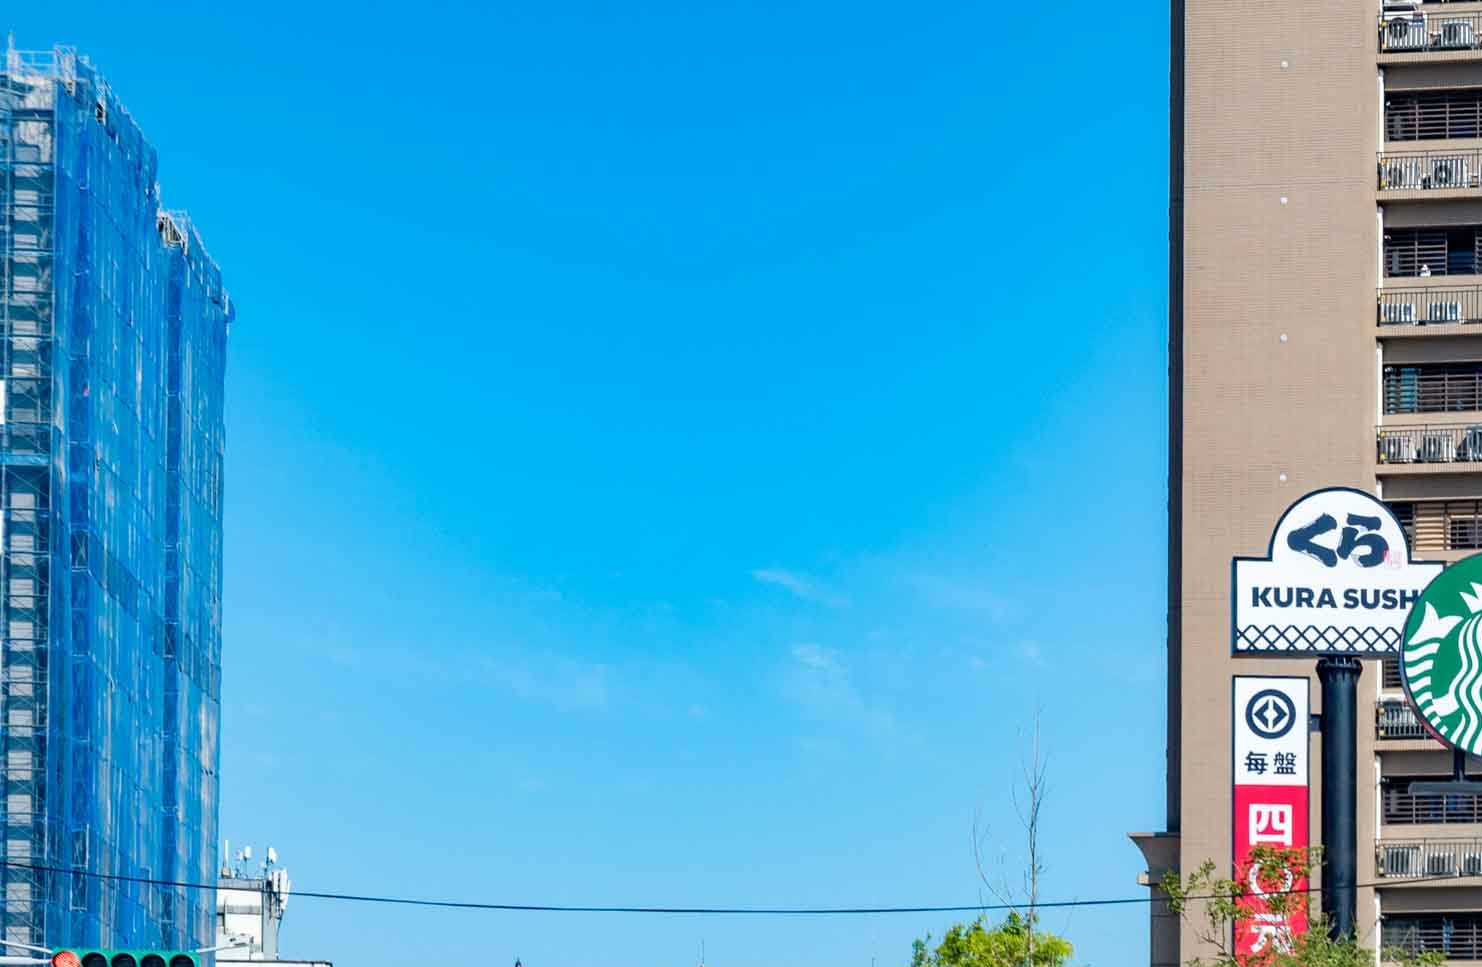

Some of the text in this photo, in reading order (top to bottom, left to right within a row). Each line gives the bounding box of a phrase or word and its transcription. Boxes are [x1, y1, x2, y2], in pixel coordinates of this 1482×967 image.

[1287, 512, 1389, 568] くら
[1252, 587, 1424, 610] KURA SUSH
